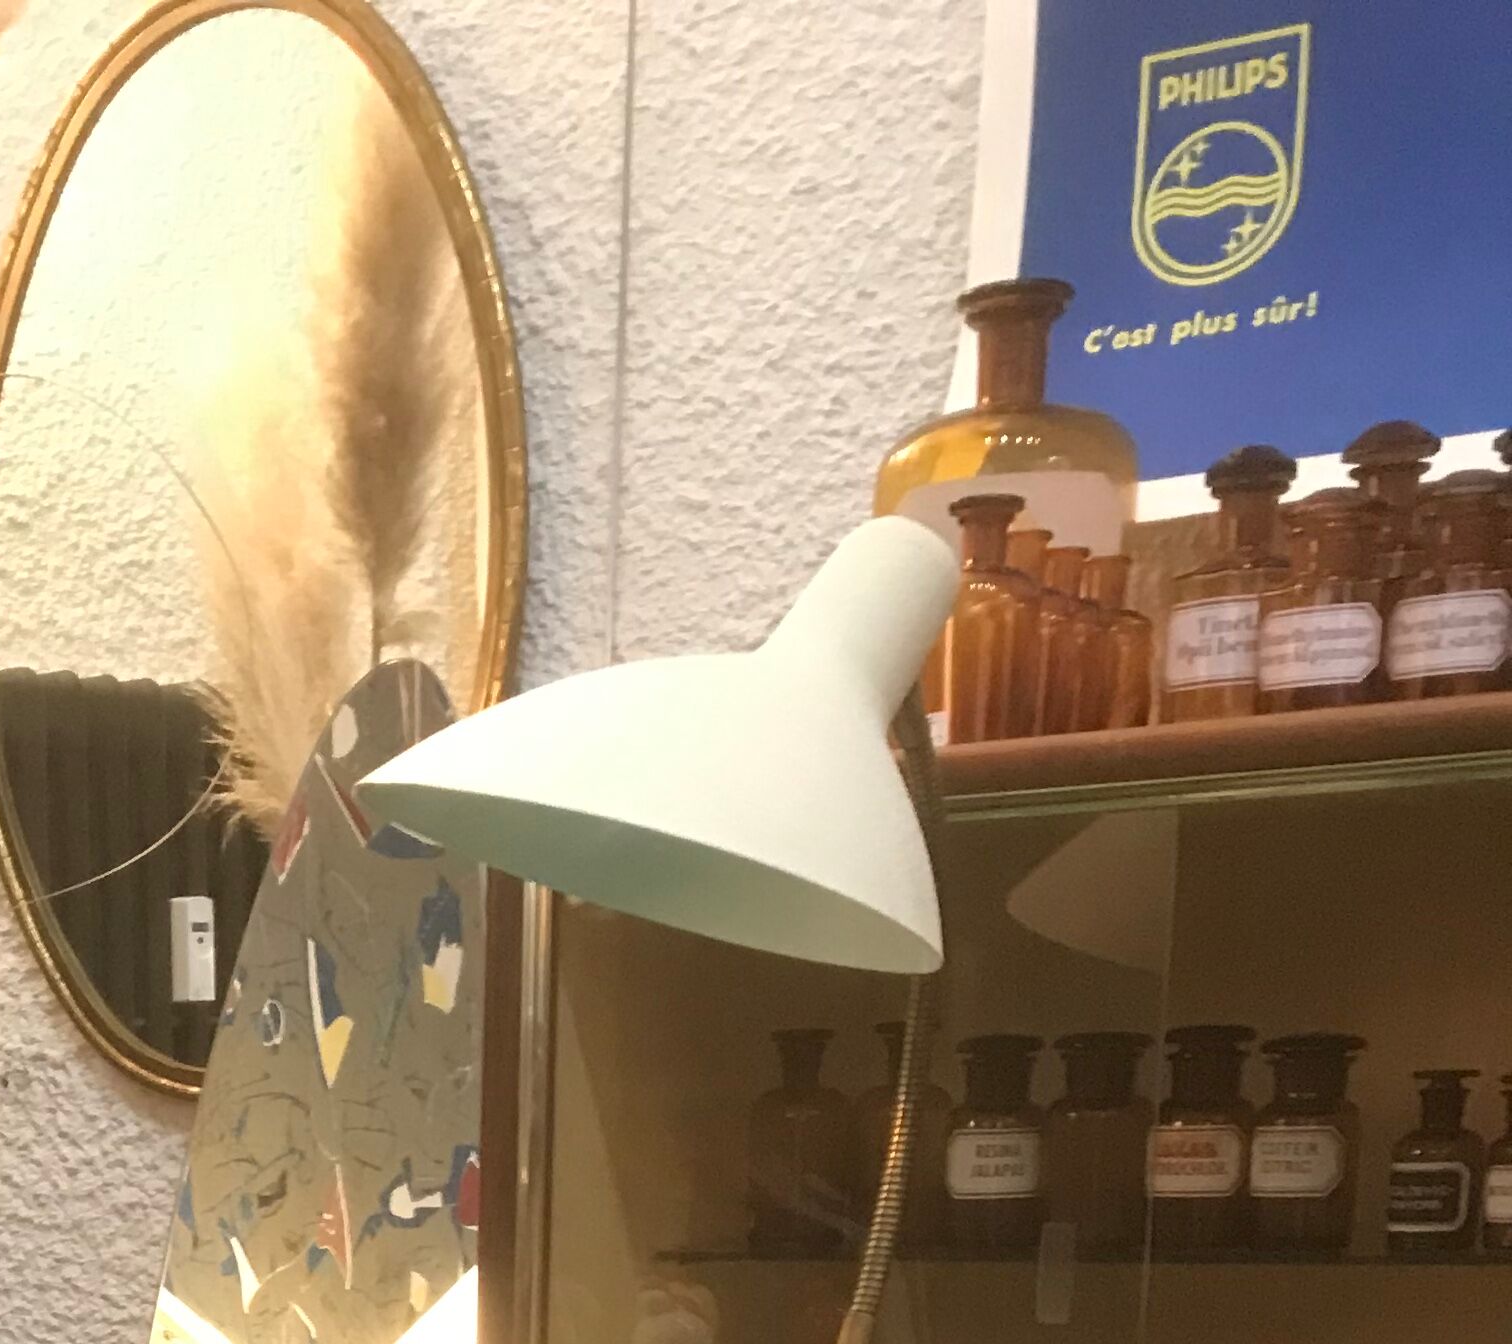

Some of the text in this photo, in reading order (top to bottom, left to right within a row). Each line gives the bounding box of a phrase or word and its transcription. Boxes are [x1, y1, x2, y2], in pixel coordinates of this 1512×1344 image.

[1158, 52, 1289, 111] PHILIPS
[1083, 291, 1319, 353] C'est plus sûr!
